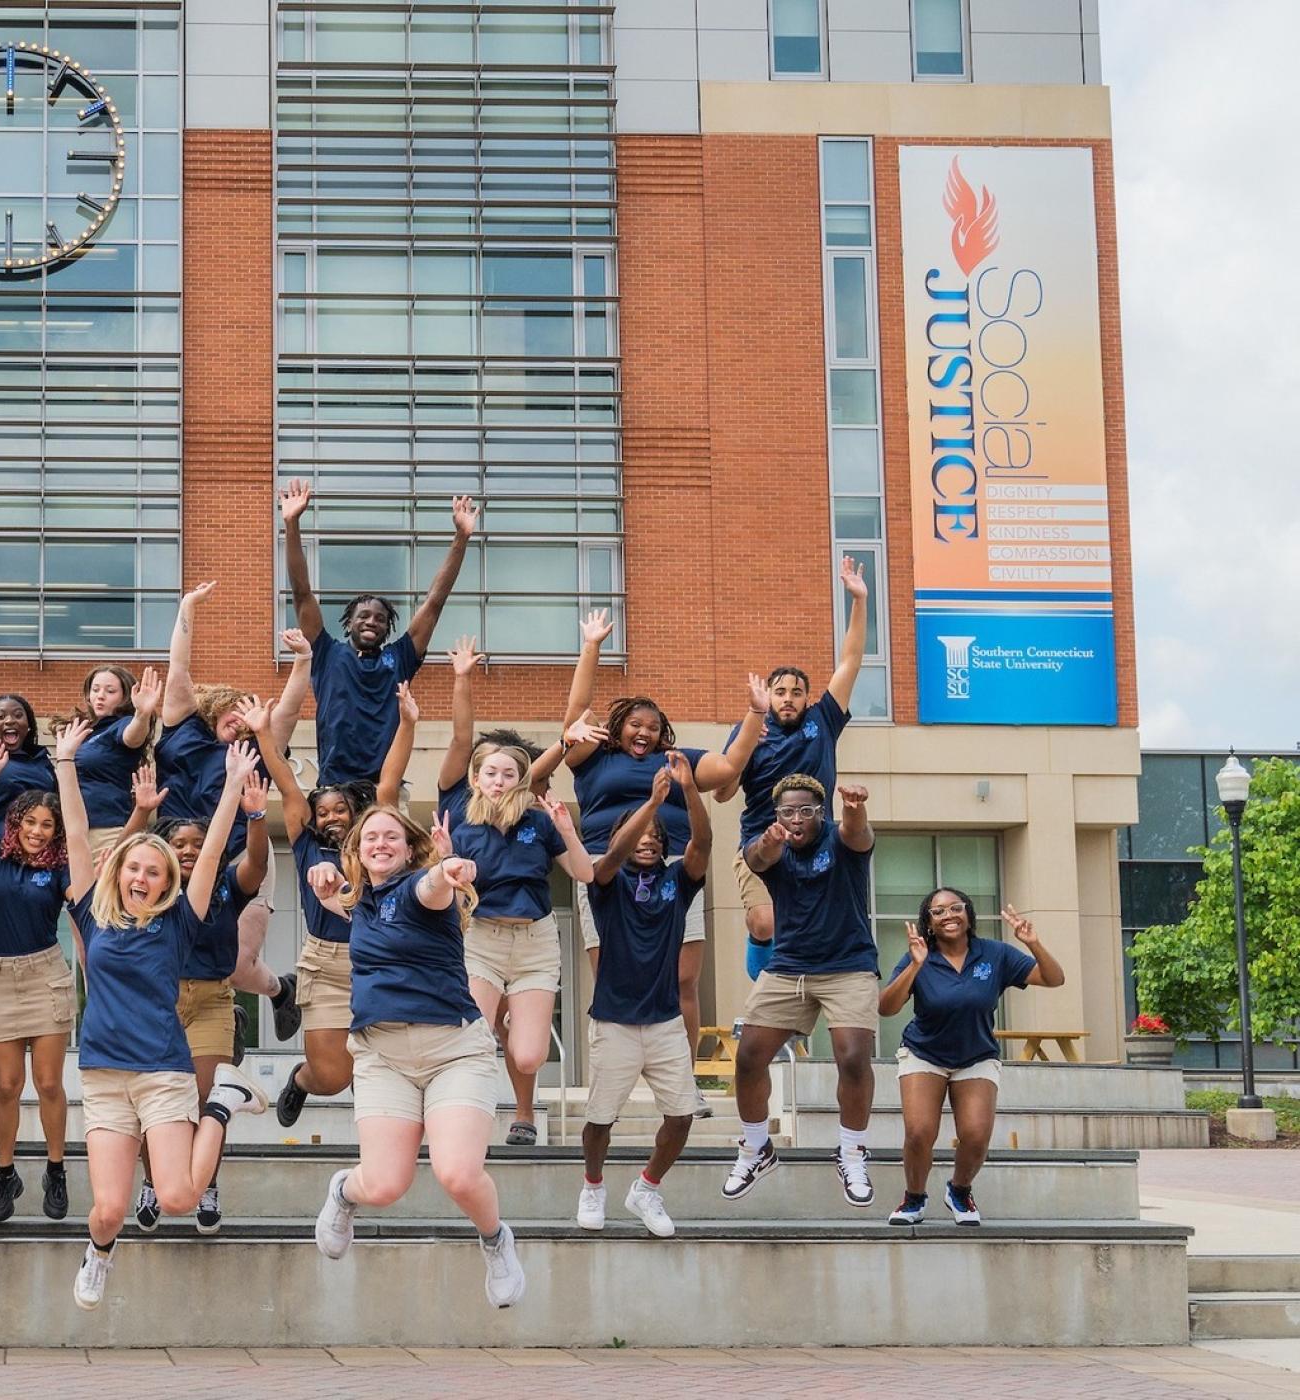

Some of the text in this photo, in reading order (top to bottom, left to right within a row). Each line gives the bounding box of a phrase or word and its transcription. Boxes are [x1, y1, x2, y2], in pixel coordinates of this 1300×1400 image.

[976, 266, 1049, 479] Social
[925, 268, 979, 543] JUSTICE
[987, 486, 1053, 498] DIGNITY
[988, 506, 1057, 518] RESPECT
[988, 527, 1070, 539] KINDNESS
[988, 547, 1099, 560] COMPASSION
[990, 567, 1053, 580] CIVILITY
[971, 646, 1094, 659] Southern Connecticut
[972, 658, 1064, 672] State University
[947, 668, 970, 681] SC
[947, 682, 970, 695] SU
